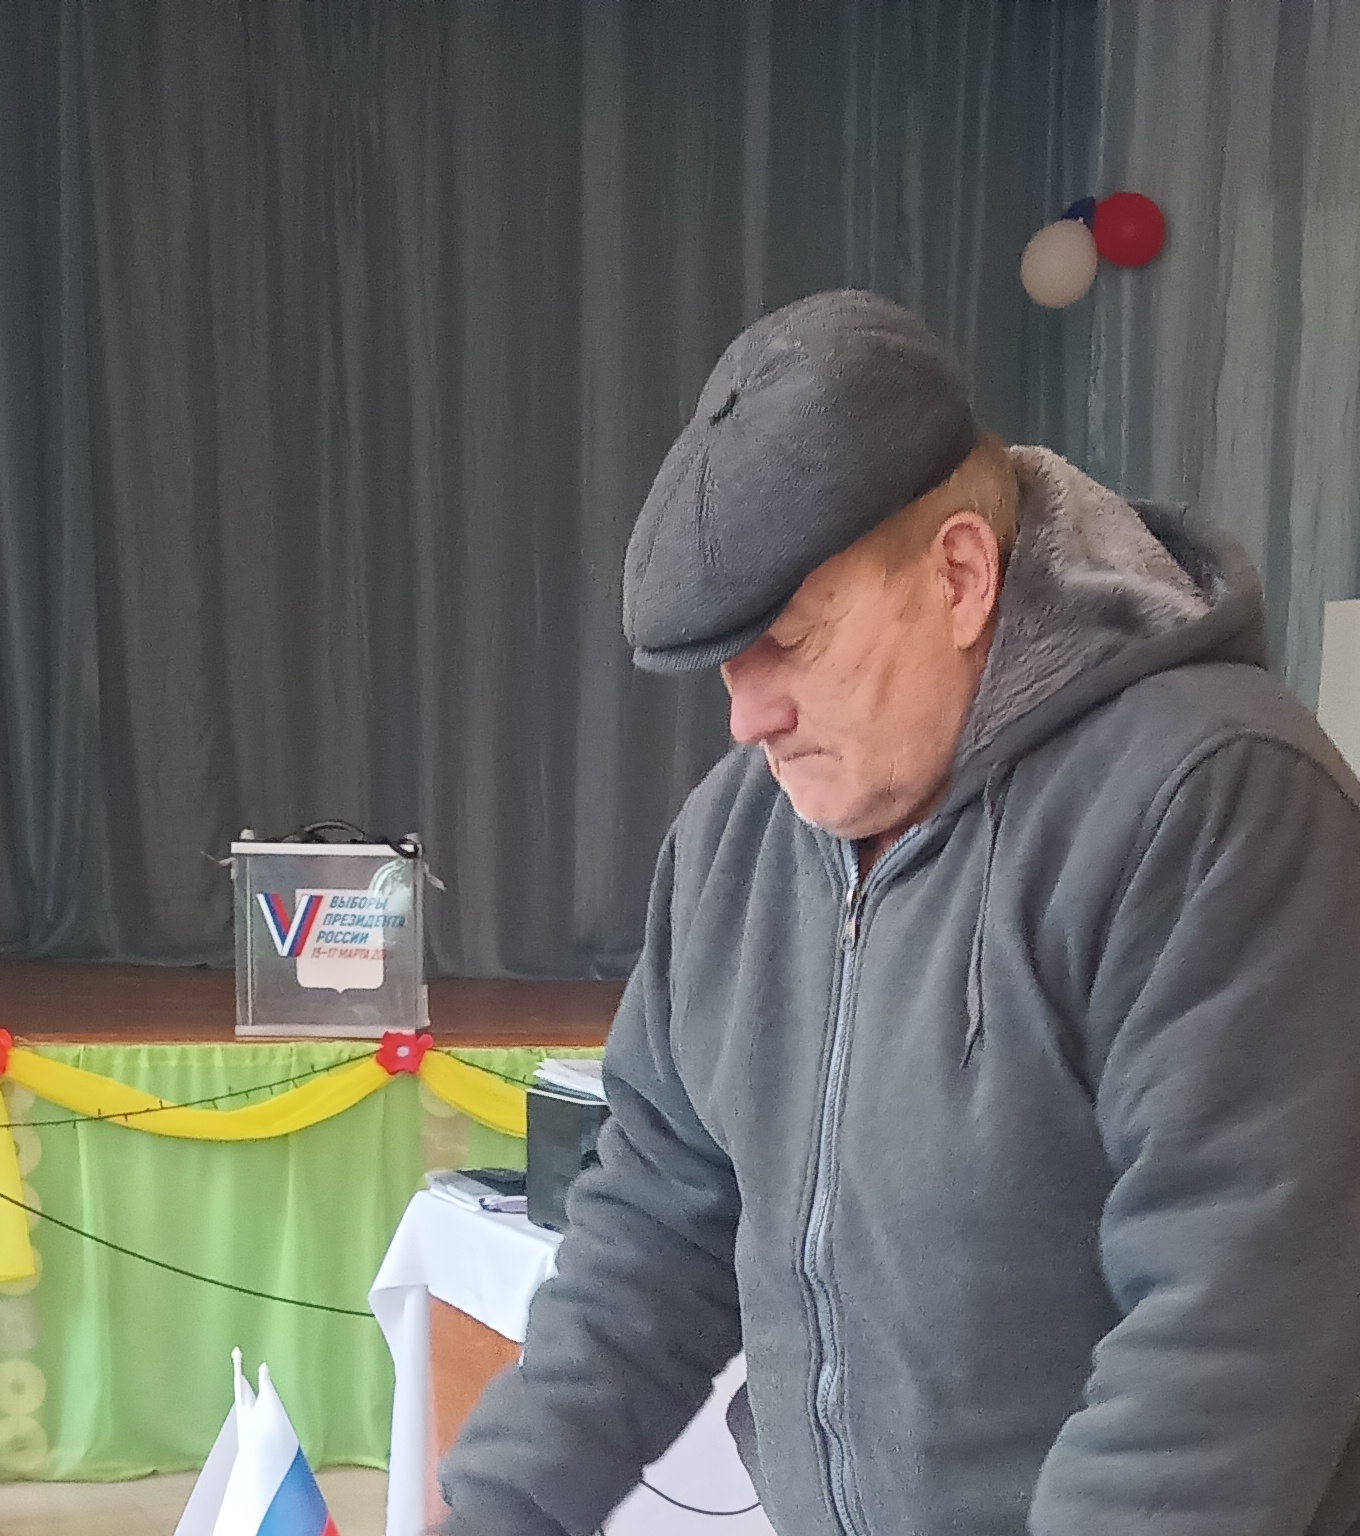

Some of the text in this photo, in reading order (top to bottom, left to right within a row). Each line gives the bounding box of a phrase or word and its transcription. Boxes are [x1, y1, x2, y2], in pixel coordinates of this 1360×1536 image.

[329, 896, 388, 910] ВЫБОРЫ
[322, 913, 405, 928] ПРЕЗИДЕНТА
[316, 930, 369, 944] РОССИИ
[340, 948, 370, 959] МАРТА
